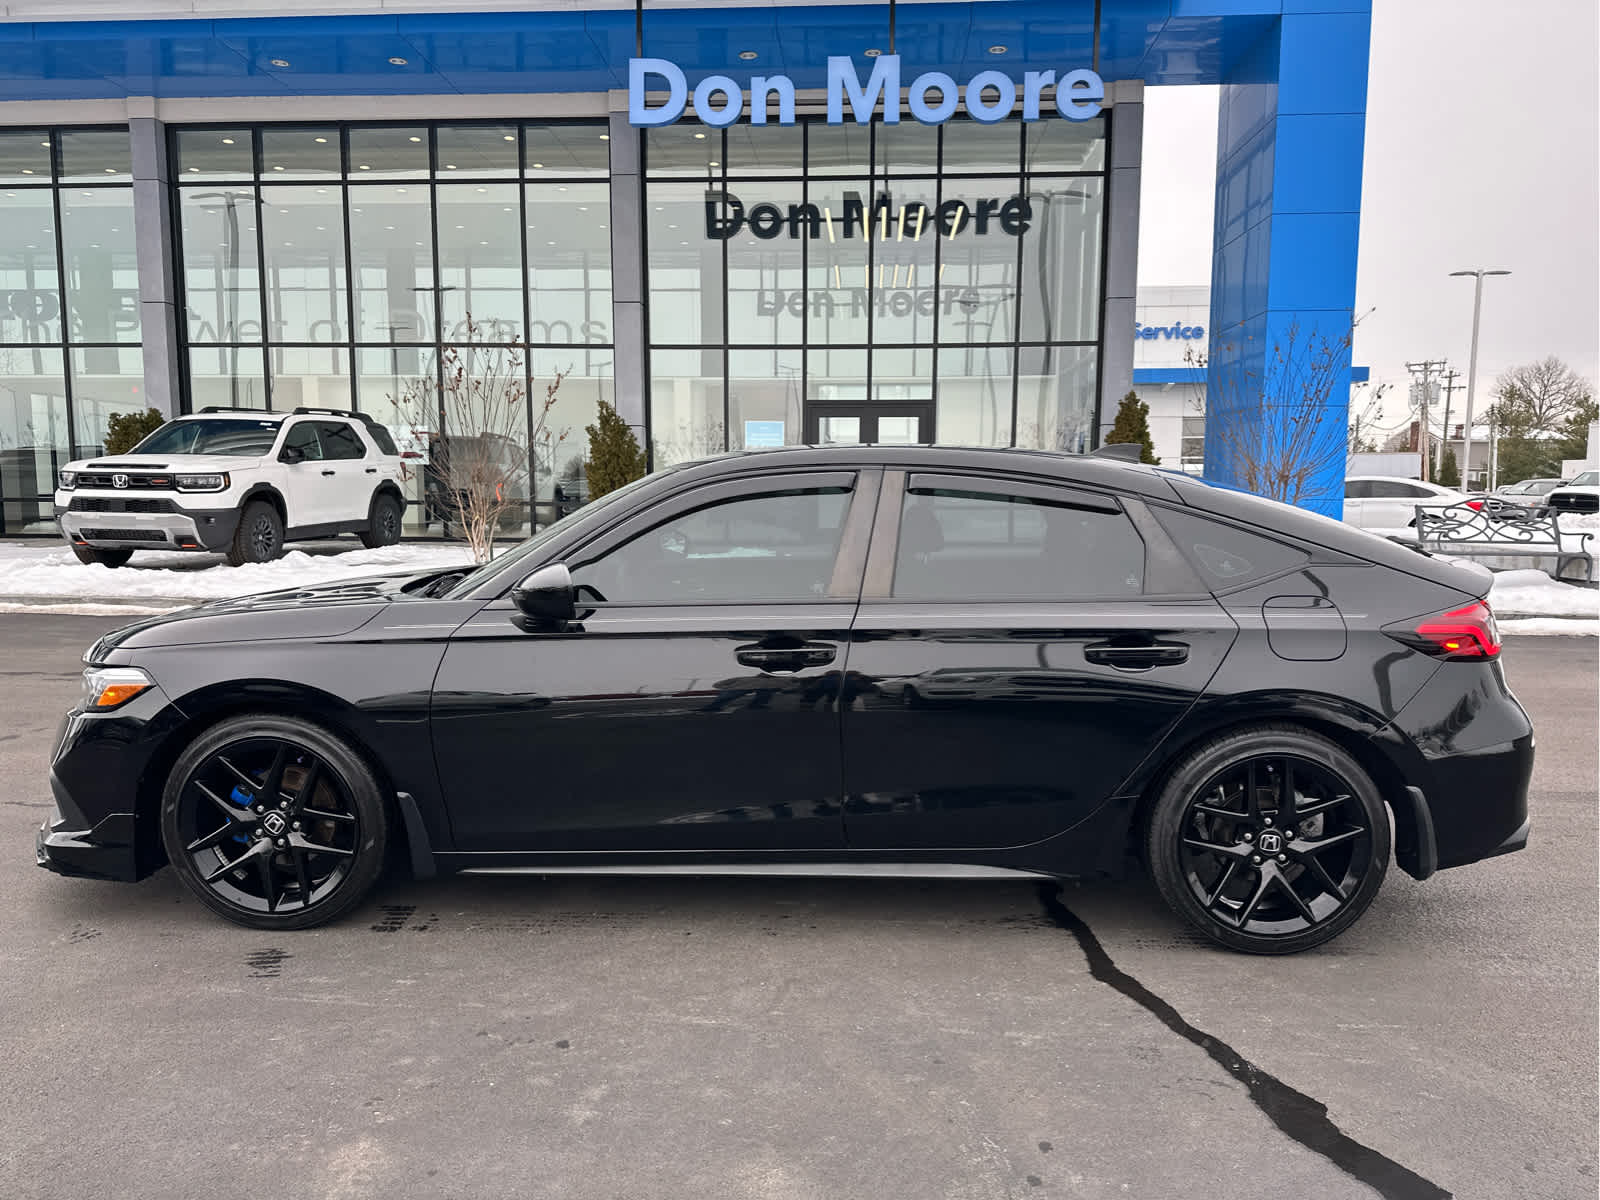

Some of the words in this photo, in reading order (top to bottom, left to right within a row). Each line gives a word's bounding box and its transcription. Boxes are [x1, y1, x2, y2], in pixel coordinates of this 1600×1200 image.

[628, 58, 796, 128] Don
[827, 55, 1105, 126] Moore
[704, 190, 821, 240] Don
[842, 190, 1034, 239] Moore
[756, 287, 822, 318] Don
[108, 310, 288, 343] Pwer
[1134, 321, 1205, 341] Service
